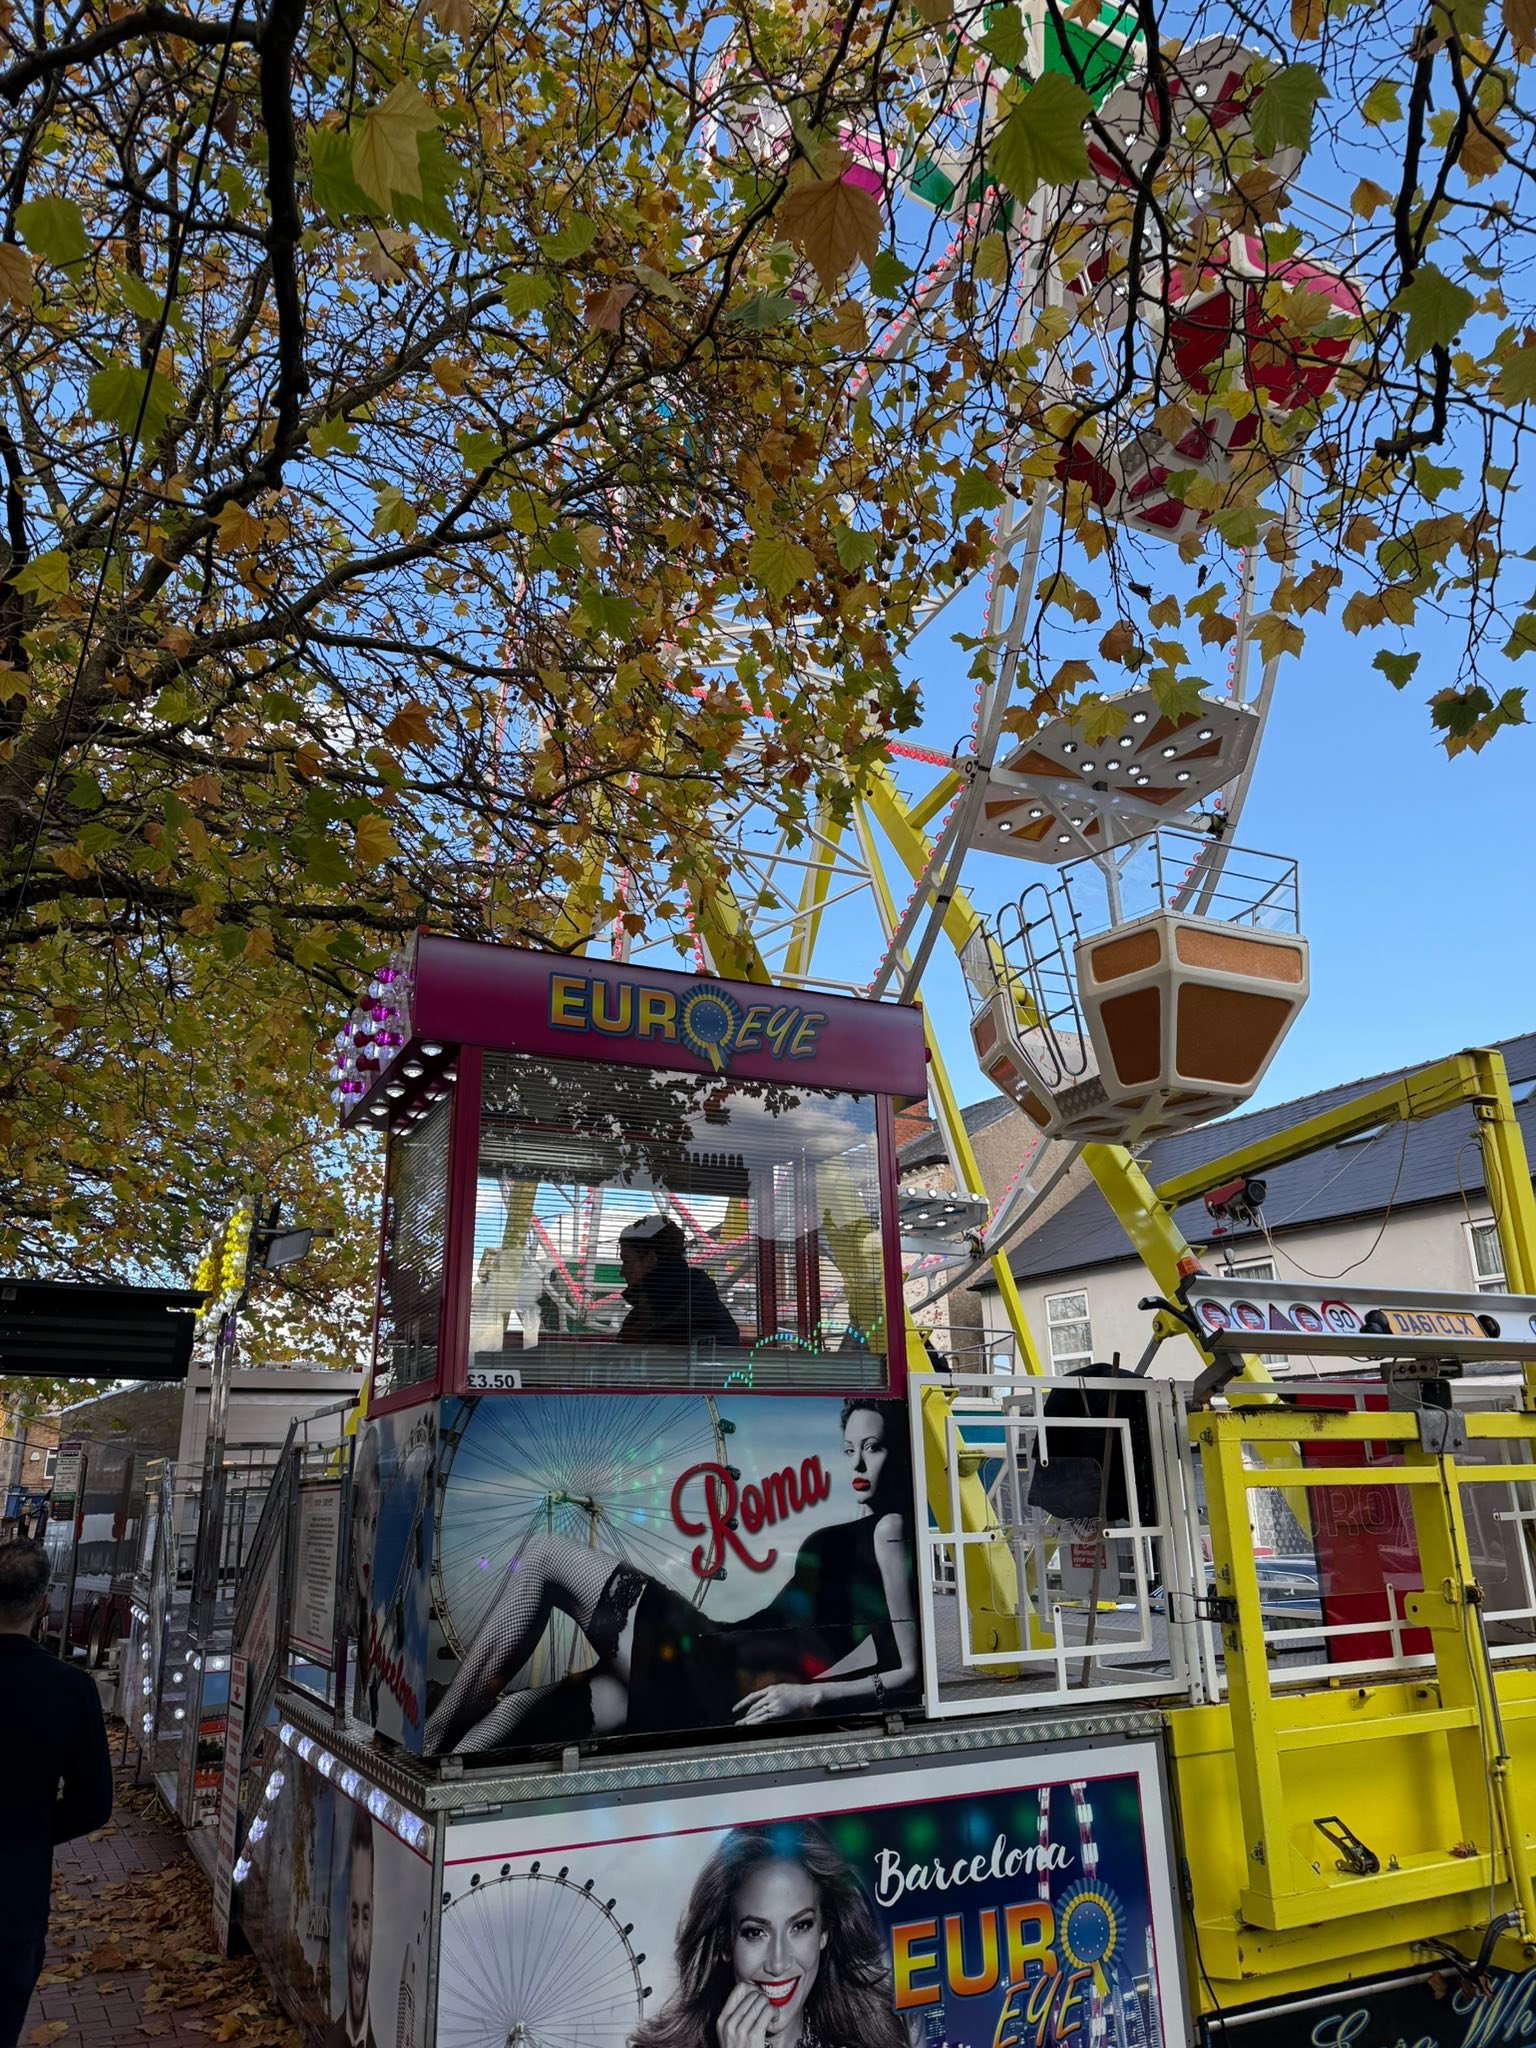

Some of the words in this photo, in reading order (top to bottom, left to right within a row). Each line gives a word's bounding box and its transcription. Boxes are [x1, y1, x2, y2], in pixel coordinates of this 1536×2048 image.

[733, 1004, 829, 1060] EYE
[1328, 1308, 1356, 1329] 90
[467, 1374, 515, 1388] £3.50
[671, 1454, 831, 1579] Roma
[368, 1614, 420, 1730] Barcelona
[874, 1832, 1076, 1908] Barcelona
[992, 1967, 1093, 2048] EYE
